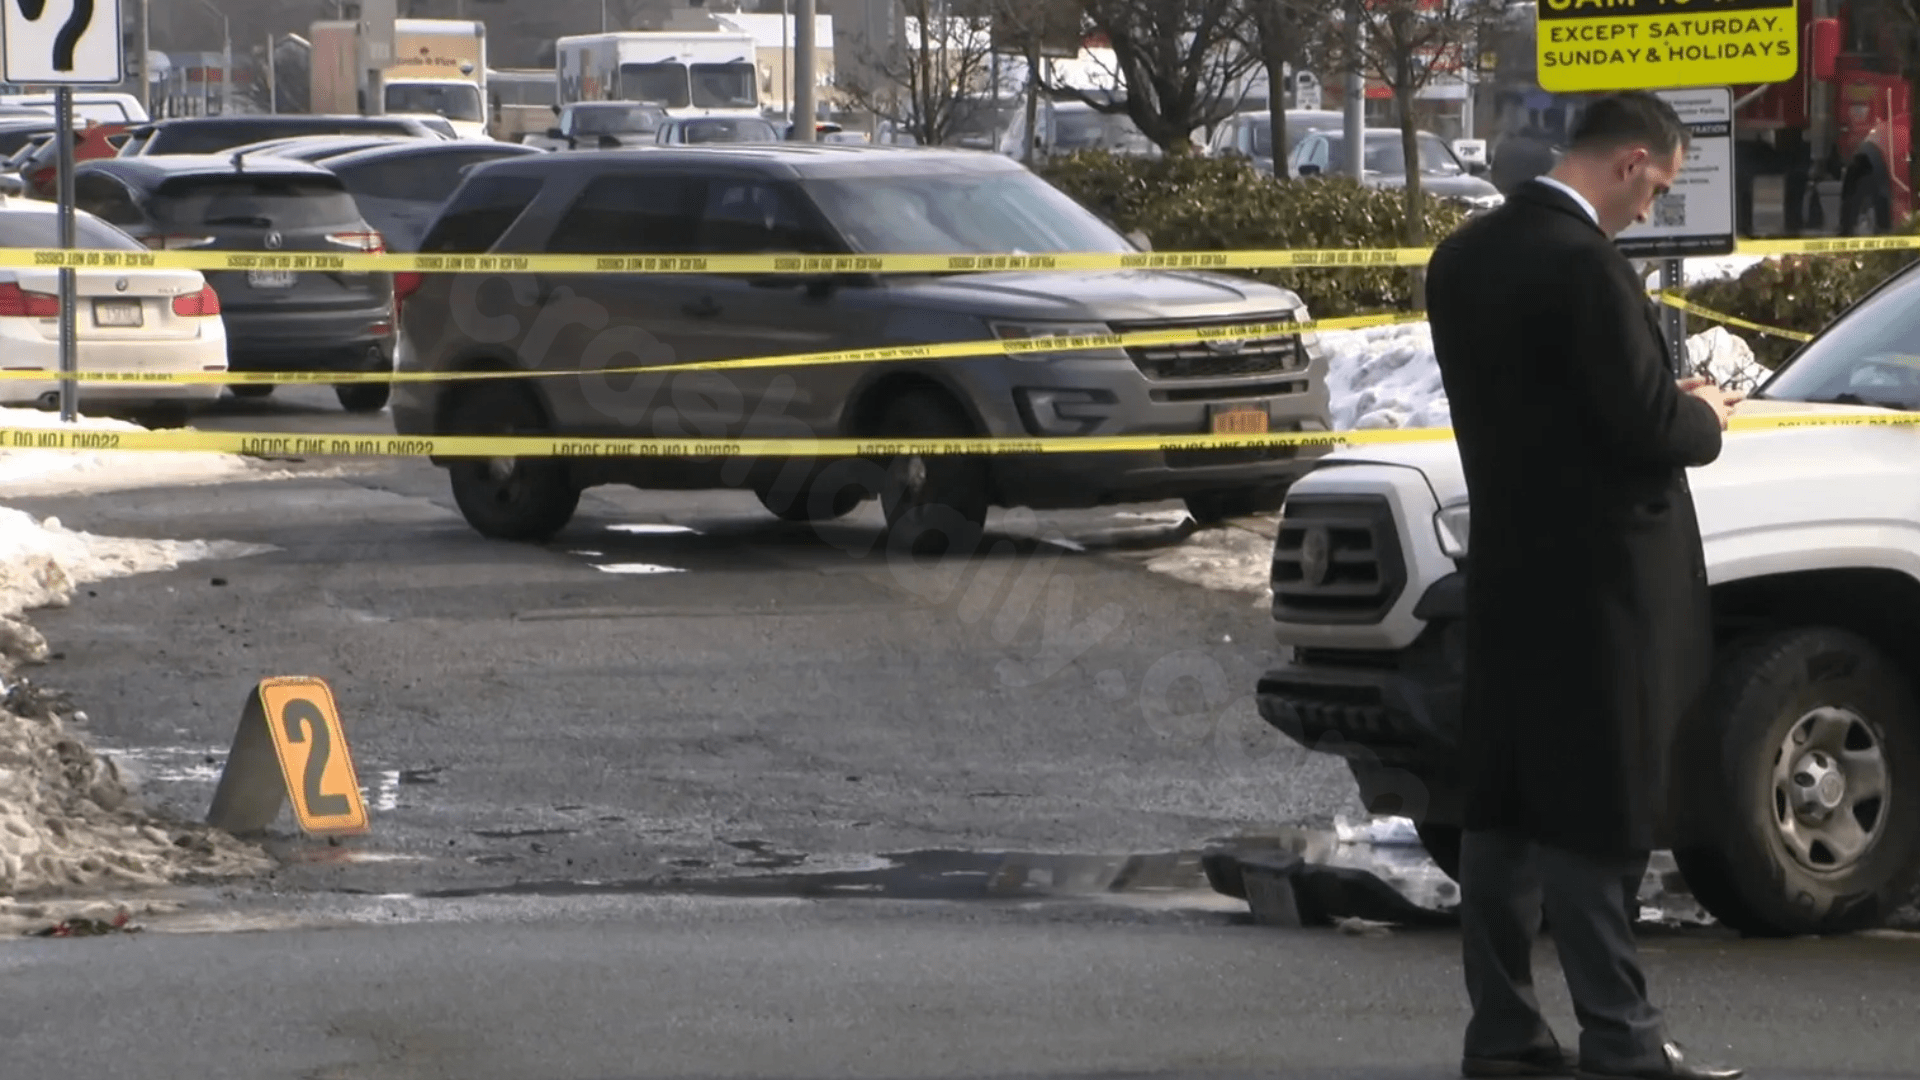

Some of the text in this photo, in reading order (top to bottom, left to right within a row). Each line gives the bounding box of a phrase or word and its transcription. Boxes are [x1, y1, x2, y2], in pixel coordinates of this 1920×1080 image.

[1550, 23, 1639, 43] EXCEPT
[1543, 40, 1791, 67] SUNDAY & HOLIDAYS
[282, 698, 351, 817] 2
